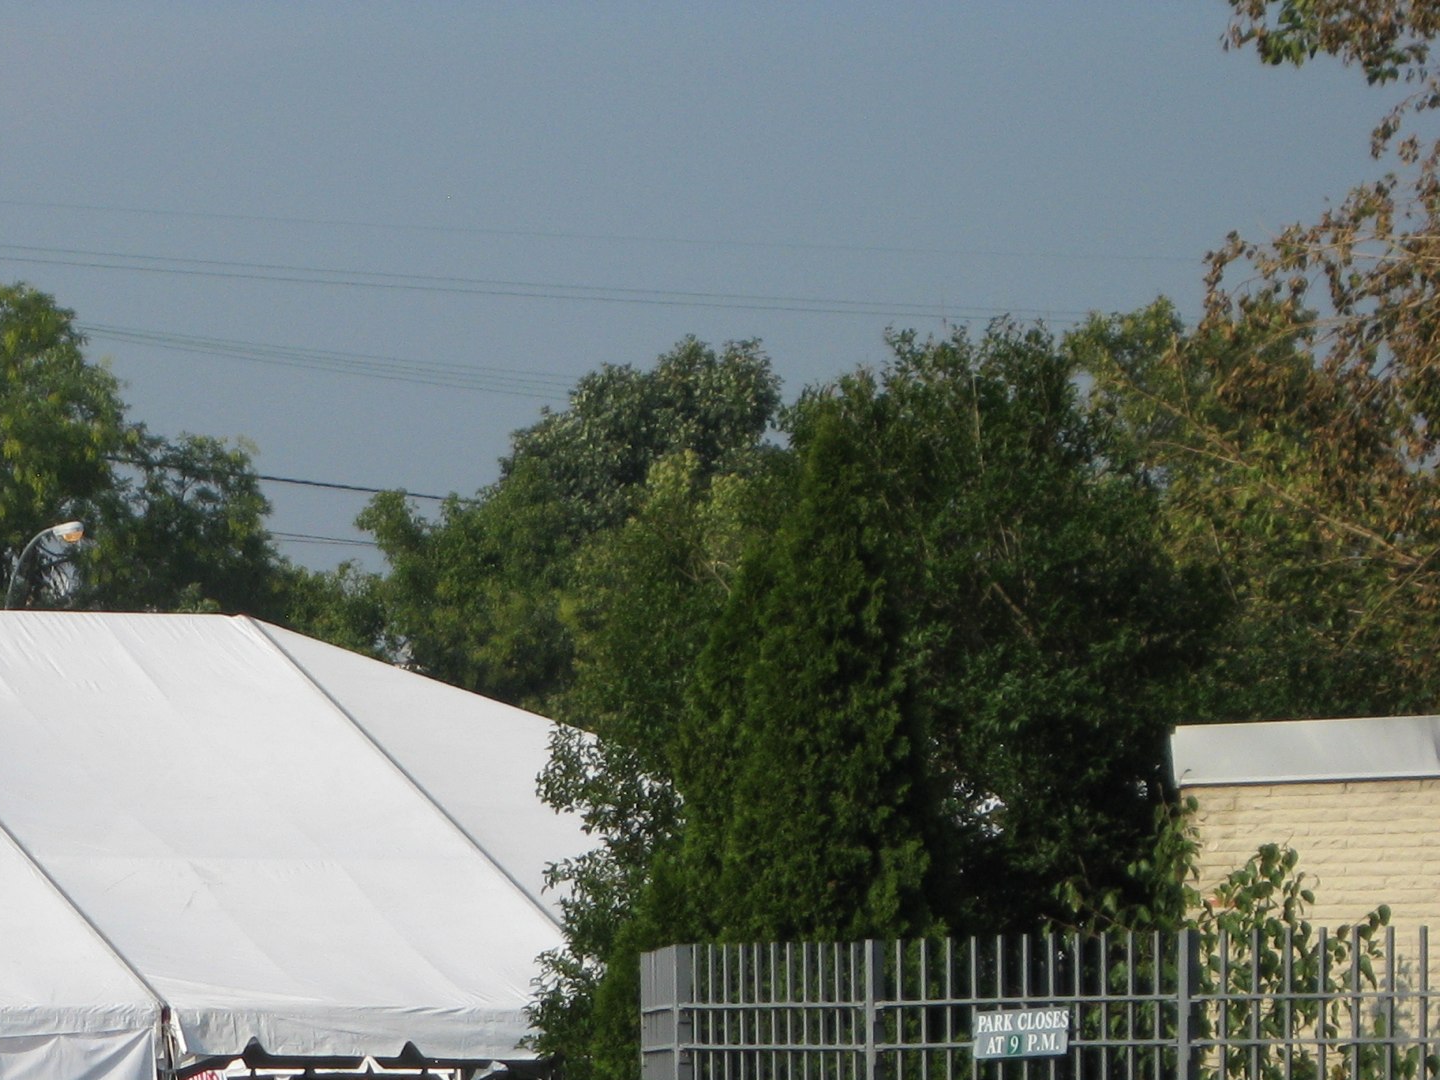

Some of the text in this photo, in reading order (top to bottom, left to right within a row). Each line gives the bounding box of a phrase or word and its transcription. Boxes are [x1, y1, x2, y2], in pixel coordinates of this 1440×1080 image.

[977, 1010, 1070, 1033] PARK CLOSES
[986, 1033, 1060, 1055] AT 9 P.M.
